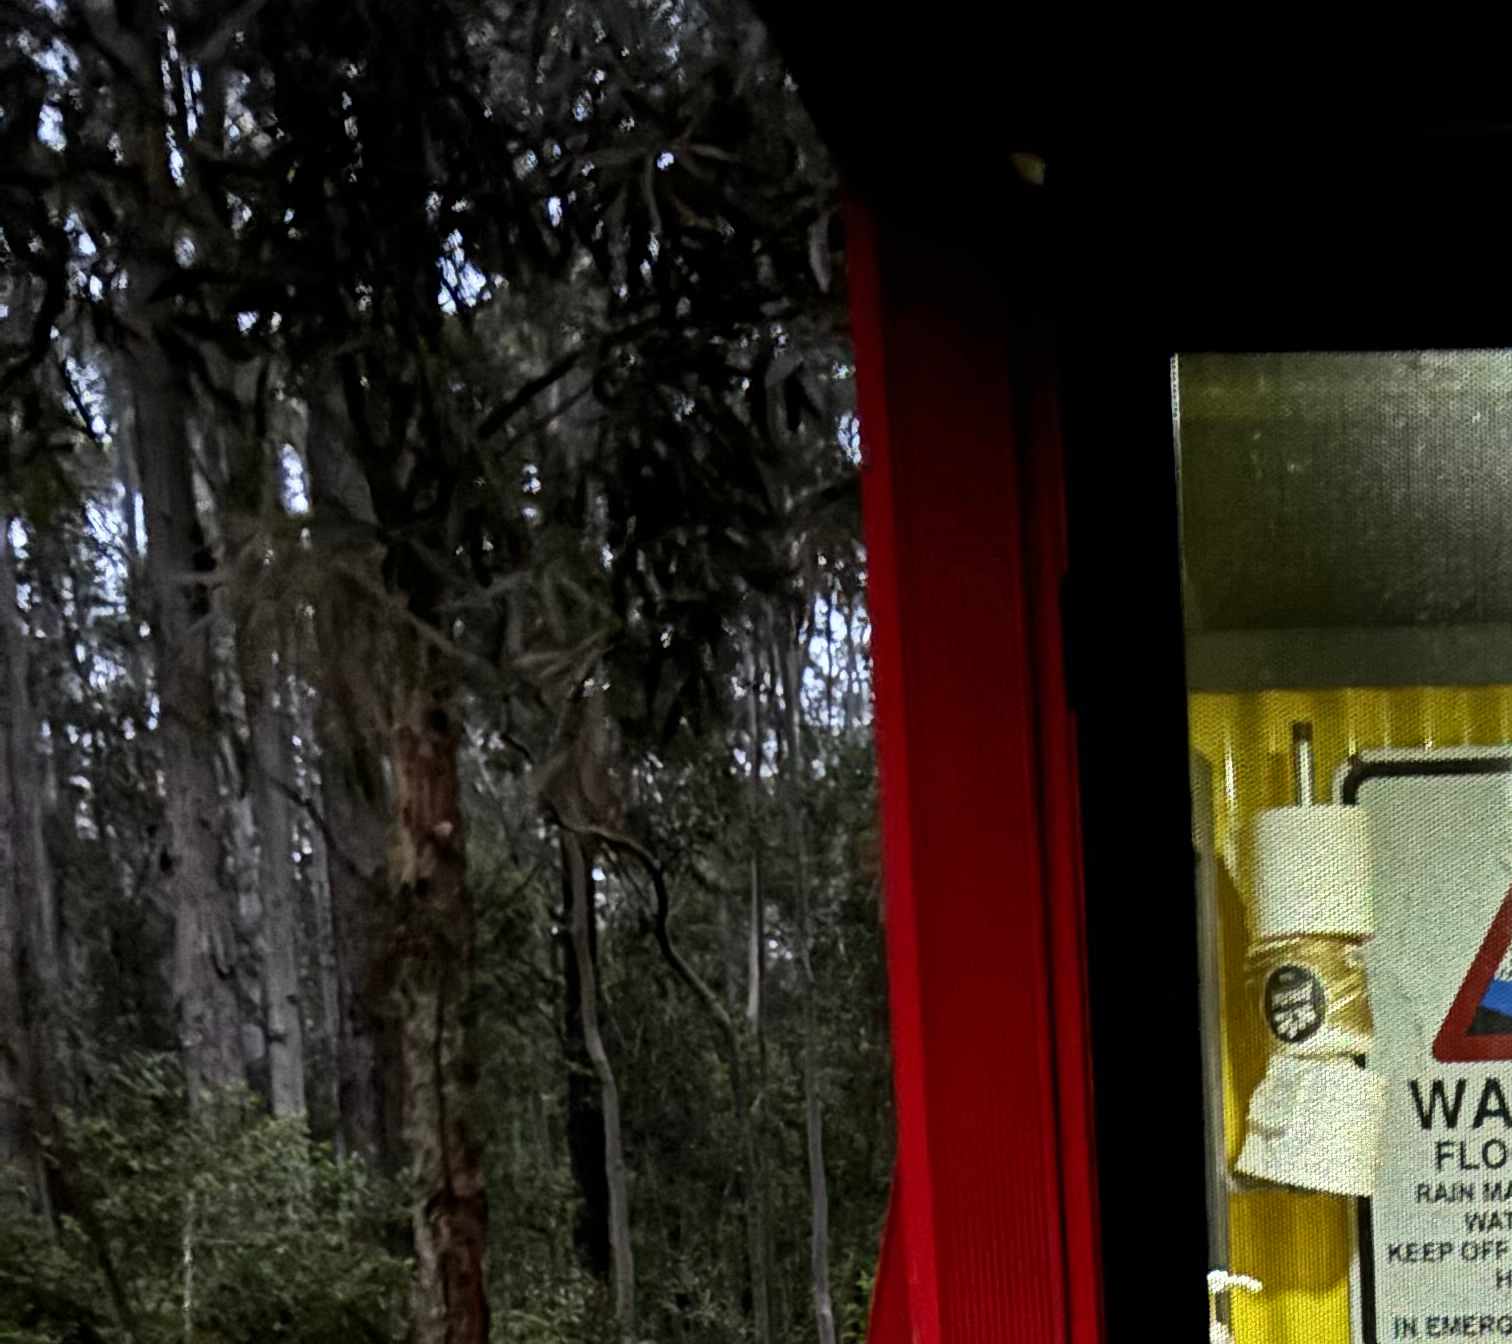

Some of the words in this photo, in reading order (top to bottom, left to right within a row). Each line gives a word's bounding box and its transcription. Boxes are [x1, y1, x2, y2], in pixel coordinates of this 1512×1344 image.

[1416, 1181, 1474, 1203] RAIN
[1387, 1241, 1454, 1263] KEEP
[1461, 1240, 1508, 1261] OFF
[1393, 1317, 1418, 1338] IN
